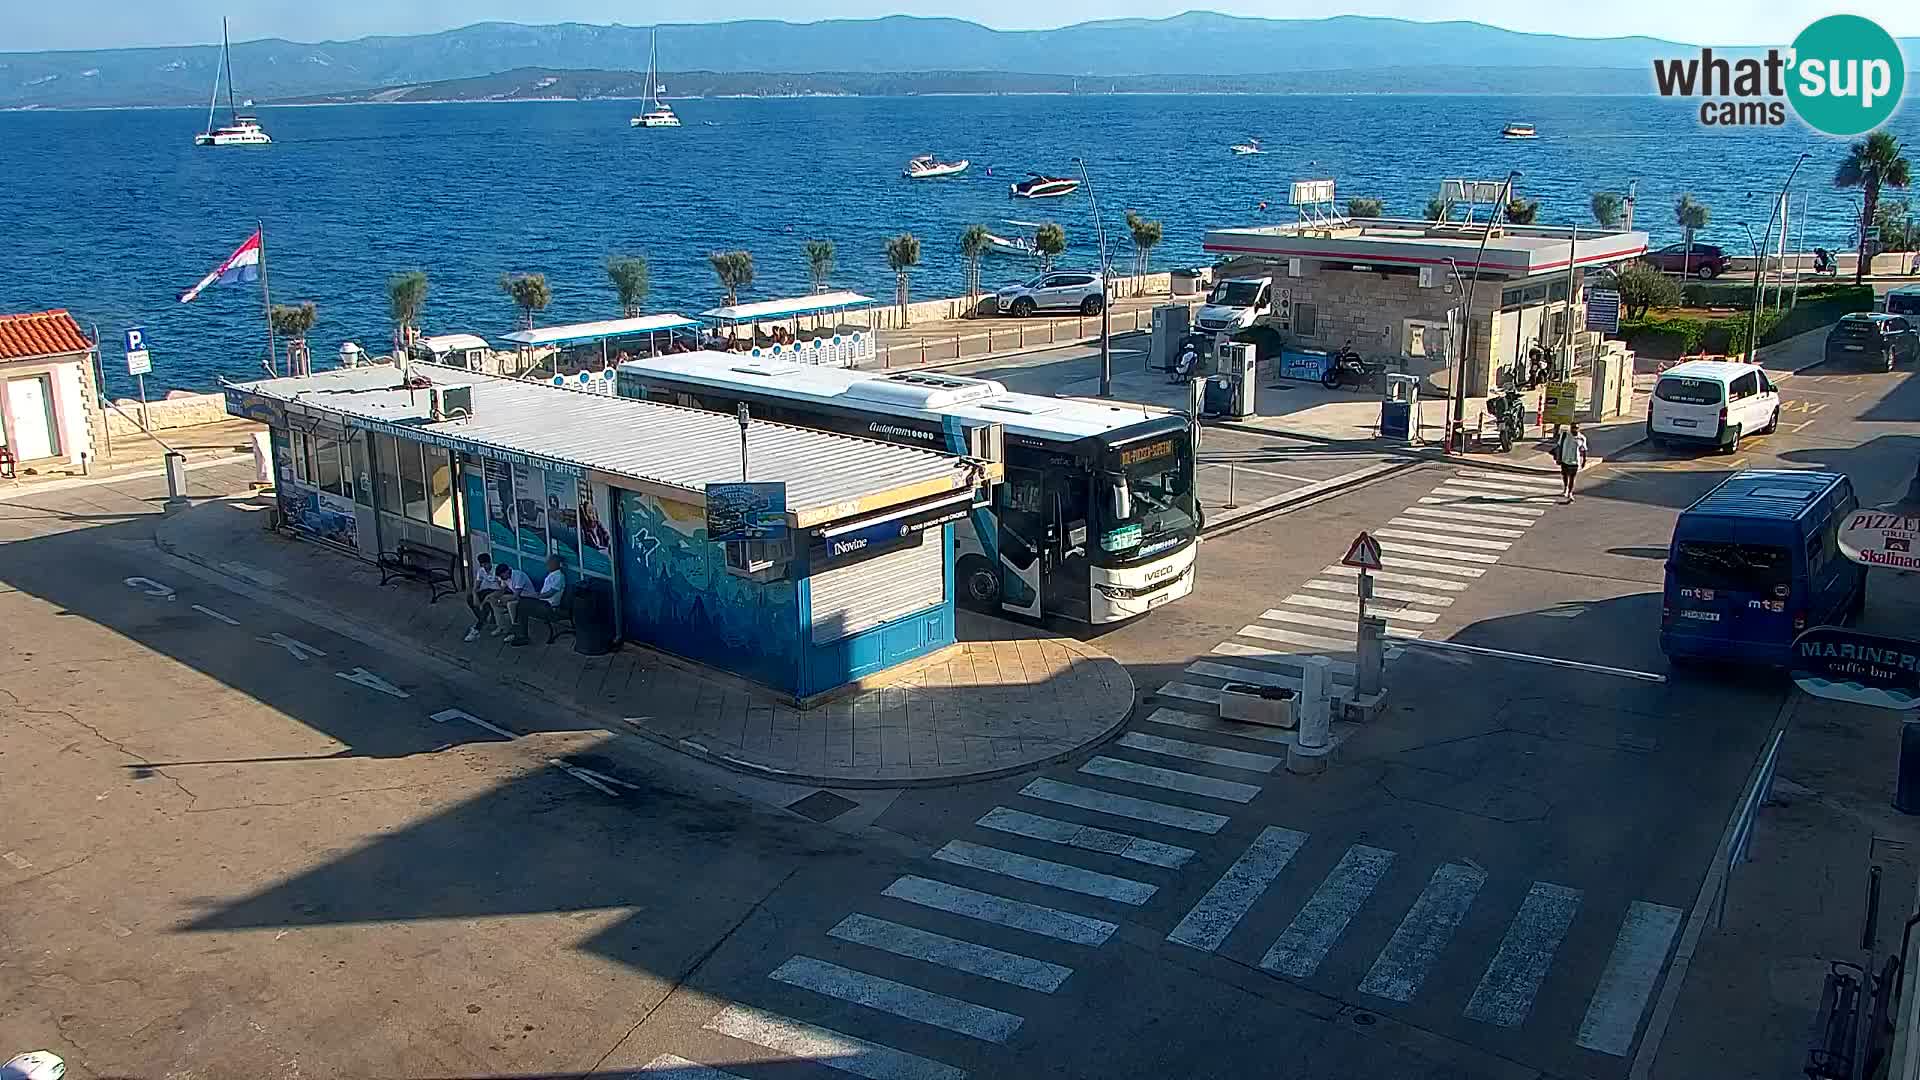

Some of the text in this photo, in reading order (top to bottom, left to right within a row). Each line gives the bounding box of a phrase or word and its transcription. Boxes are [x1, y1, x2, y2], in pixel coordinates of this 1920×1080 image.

[128, 330, 142, 350] P
[395, 427, 435, 444] AUTOBUSNA
[436, 437, 467, 451] POSTAJA
[477, 446, 492, 457] BUS
[494, 450, 525, 464] STATION
[528, 457, 553, 471] TICKET
[555, 463, 582, 477] OFFICE
[1848, 514, 1920, 533] PIZZE
[1144, 565, 1173, 582] IVECO
[1681, 588, 1714, 600] mts
[1748, 600, 1784, 612] mts
[1870, 665, 1897, 679] bar
